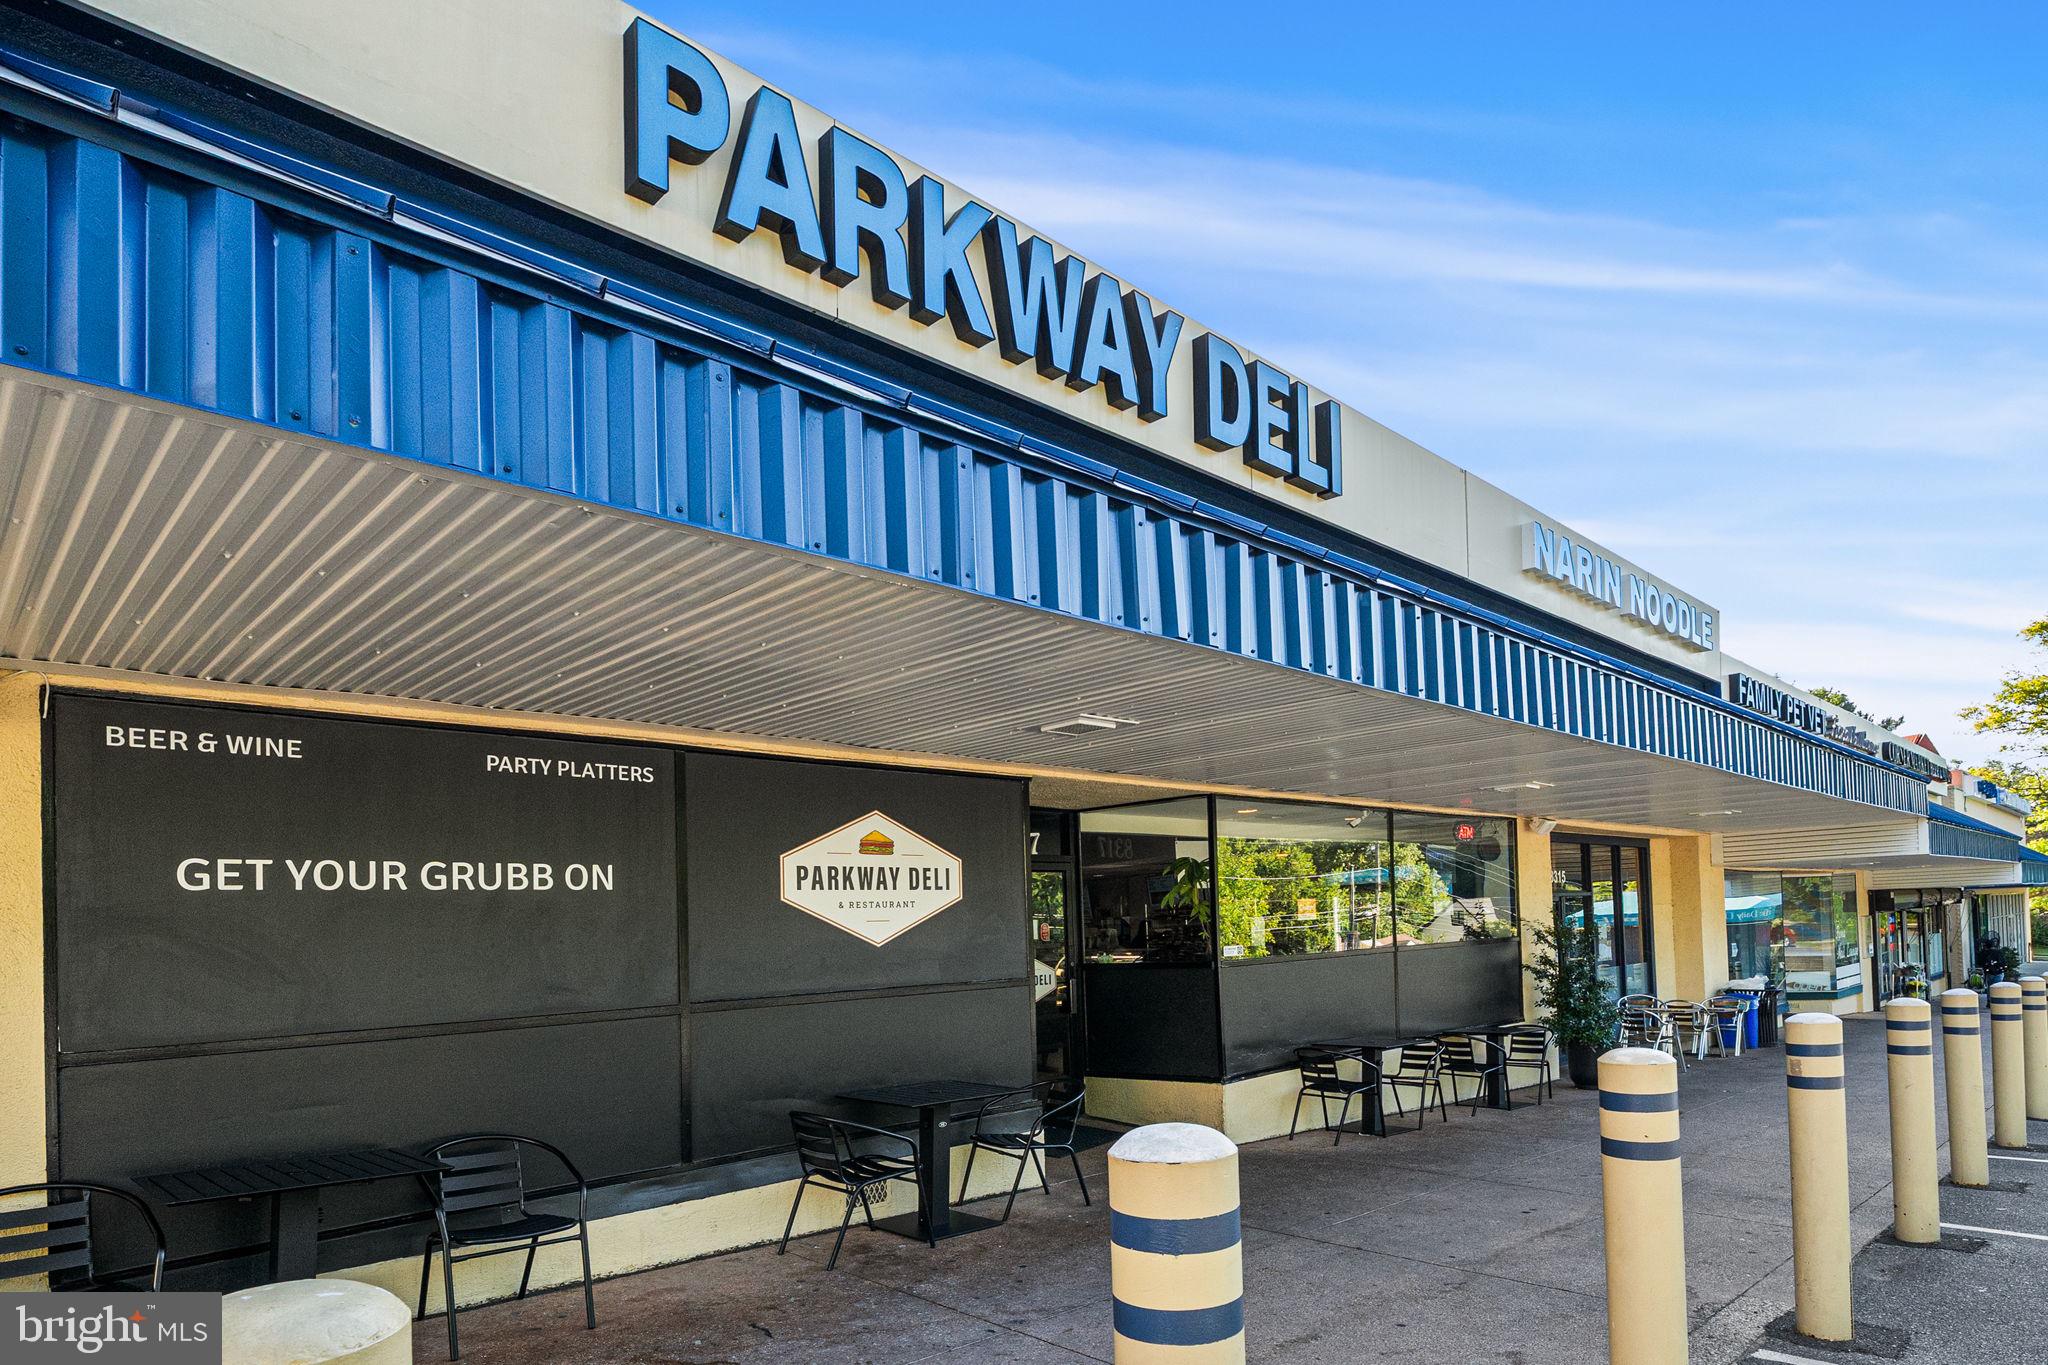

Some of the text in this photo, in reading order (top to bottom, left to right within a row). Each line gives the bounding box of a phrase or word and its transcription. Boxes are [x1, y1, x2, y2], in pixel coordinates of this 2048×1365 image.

[624, 16, 1343, 500] PARKWAY DELI
[1533, 521, 1714, 651] NARIN NOODLE
[1738, 672, 1784, 719] FAMILY
[1786, 693, 1806, 728] PET
[1807, 703, 1827, 735] VET
[105, 725, 303, 759] BEER & WINE
[486, 754, 655, 784] PARTY PLATTERS
[1458, 825, 1474, 839] ATM
[175, 857, 614, 891] GET YOUR GRUBB ON
[796, 865, 951, 891] PARKWAY DELI
[838, 900, 916, 909] & RESTAURANT
